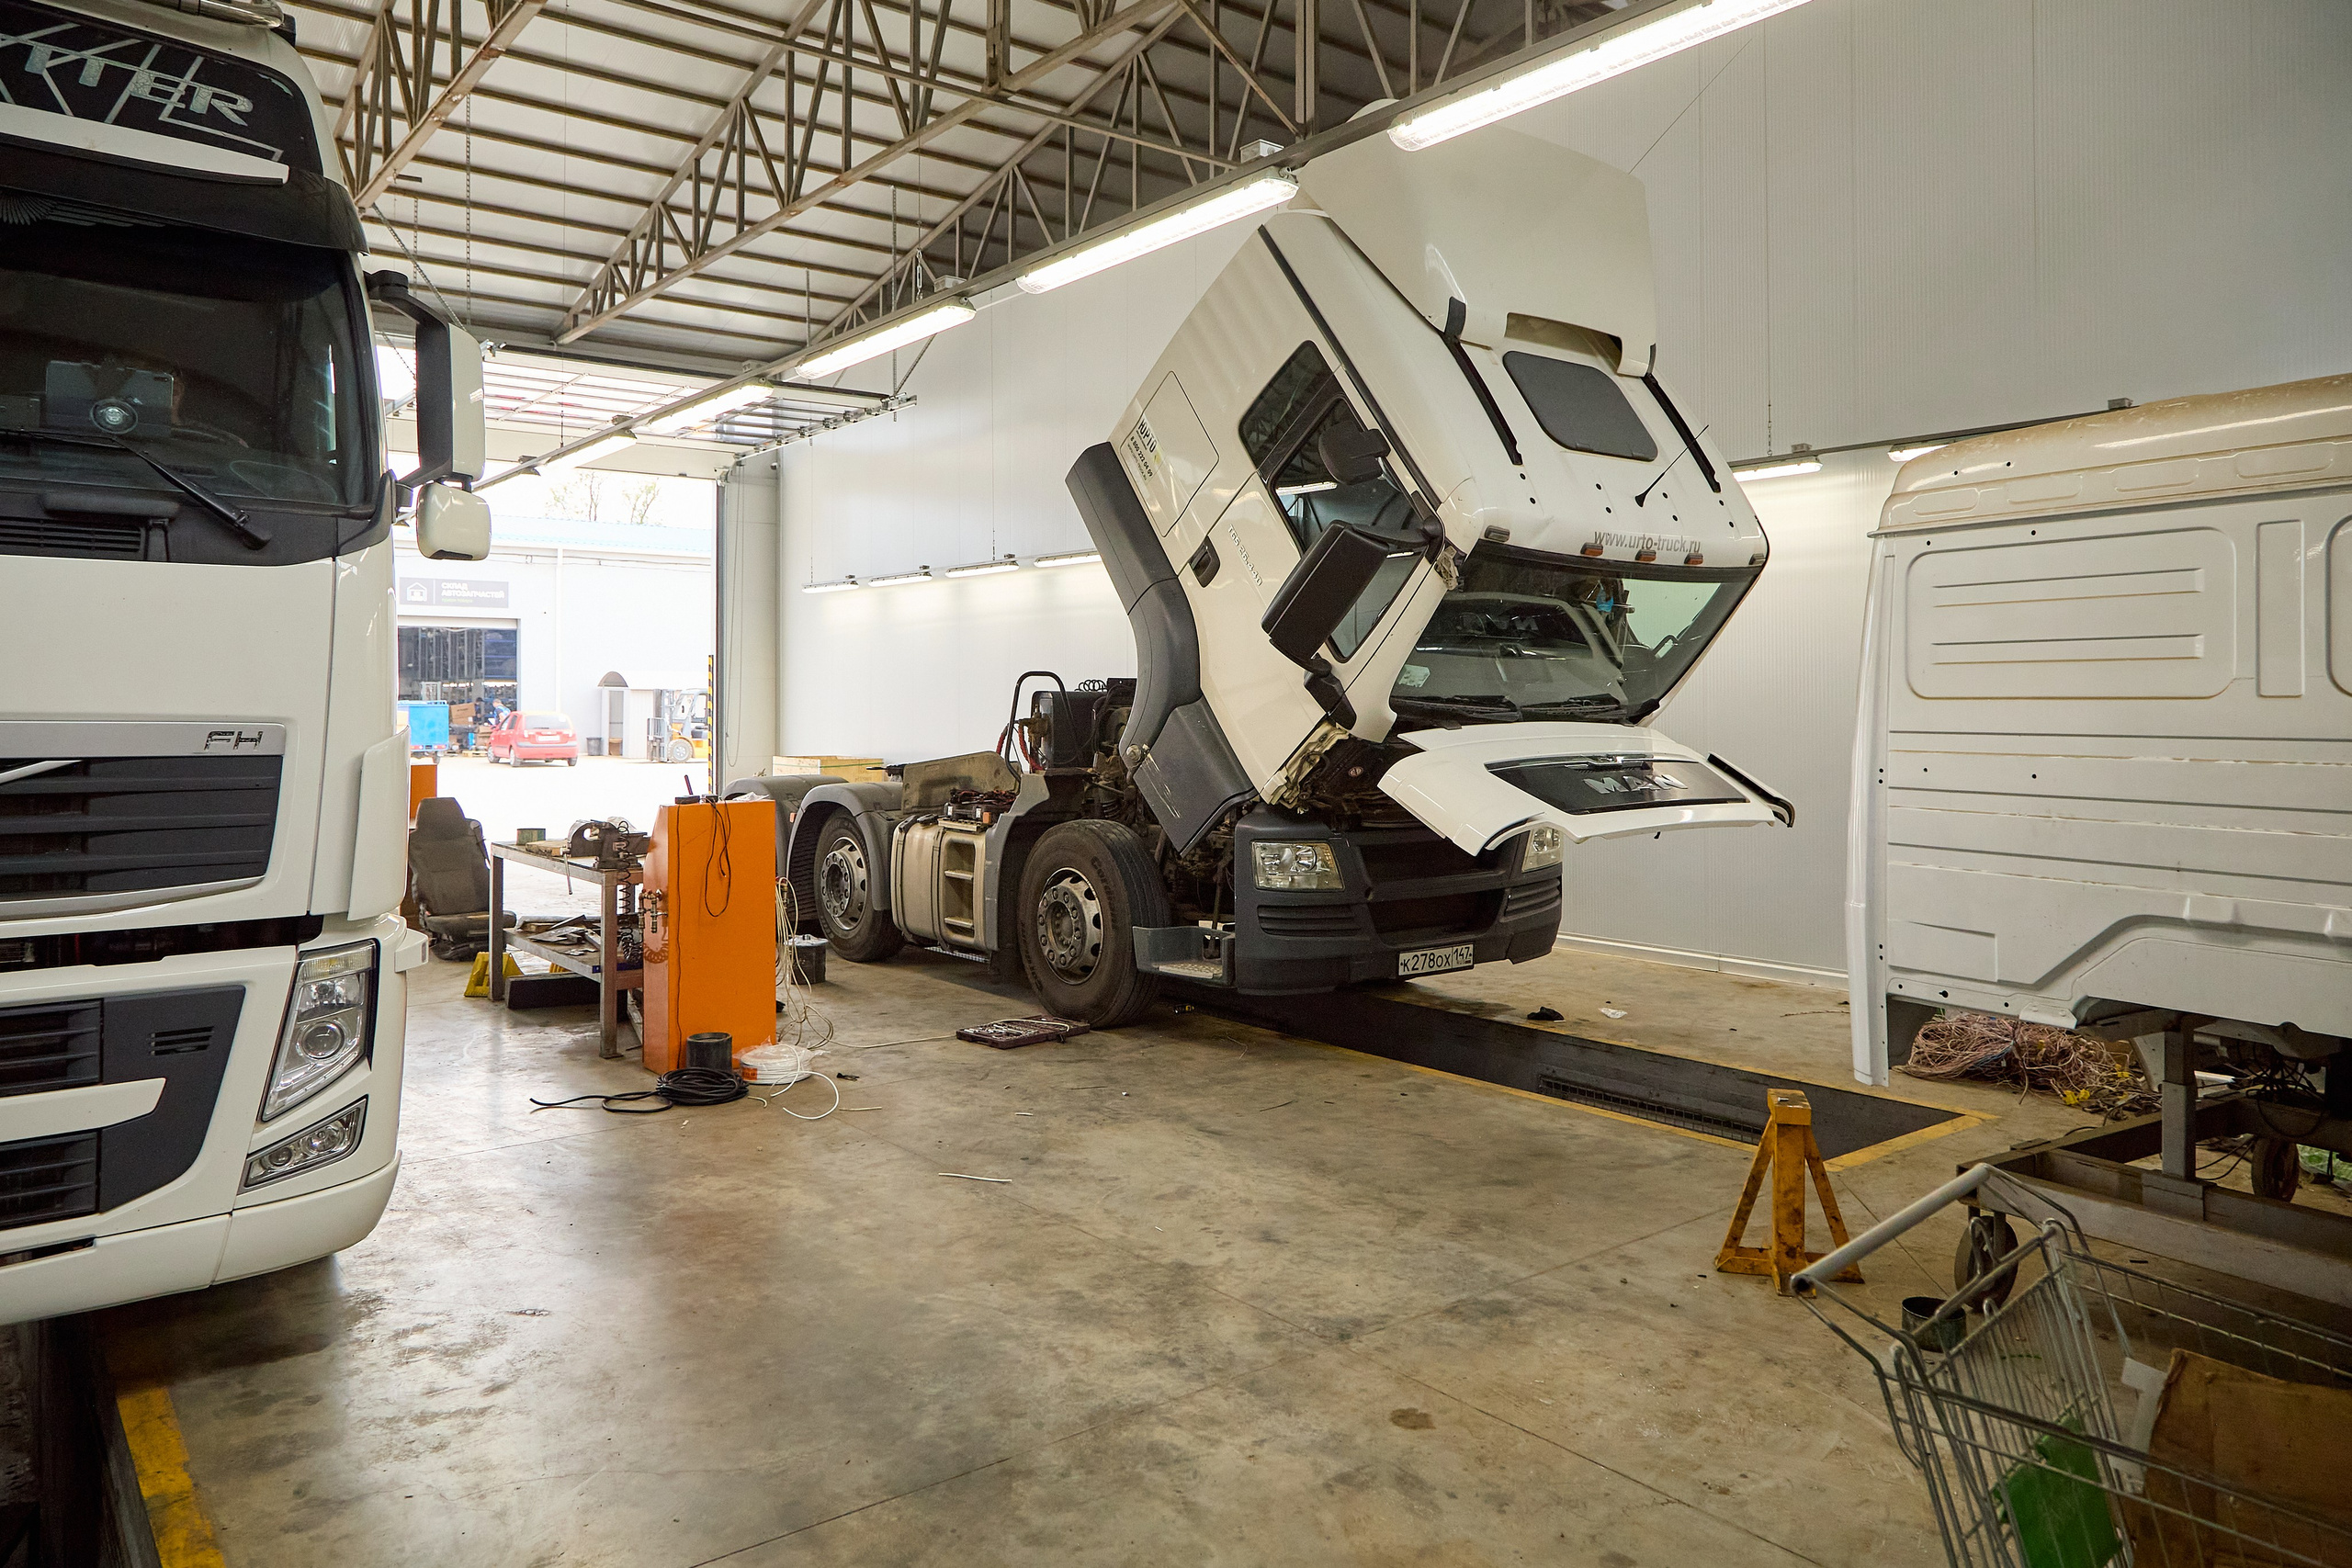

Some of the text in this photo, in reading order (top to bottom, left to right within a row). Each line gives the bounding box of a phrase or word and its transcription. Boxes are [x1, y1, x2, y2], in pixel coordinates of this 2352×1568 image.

[1138, 419, 1157, 453] ЮРТО
[1594, 531, 1701, 555] www.urto-truck.ru
[1228, 524, 1263, 587] TGS 26.440
[441, 581, 469, 592] СКЛАД
[441, 589, 505, 600] АВТОЗАПЧАСТЕЙ
[204, 731, 264, 750] FH
[1583, 773, 1689, 795] MAN
[1453, 945, 1470, 961] 147
